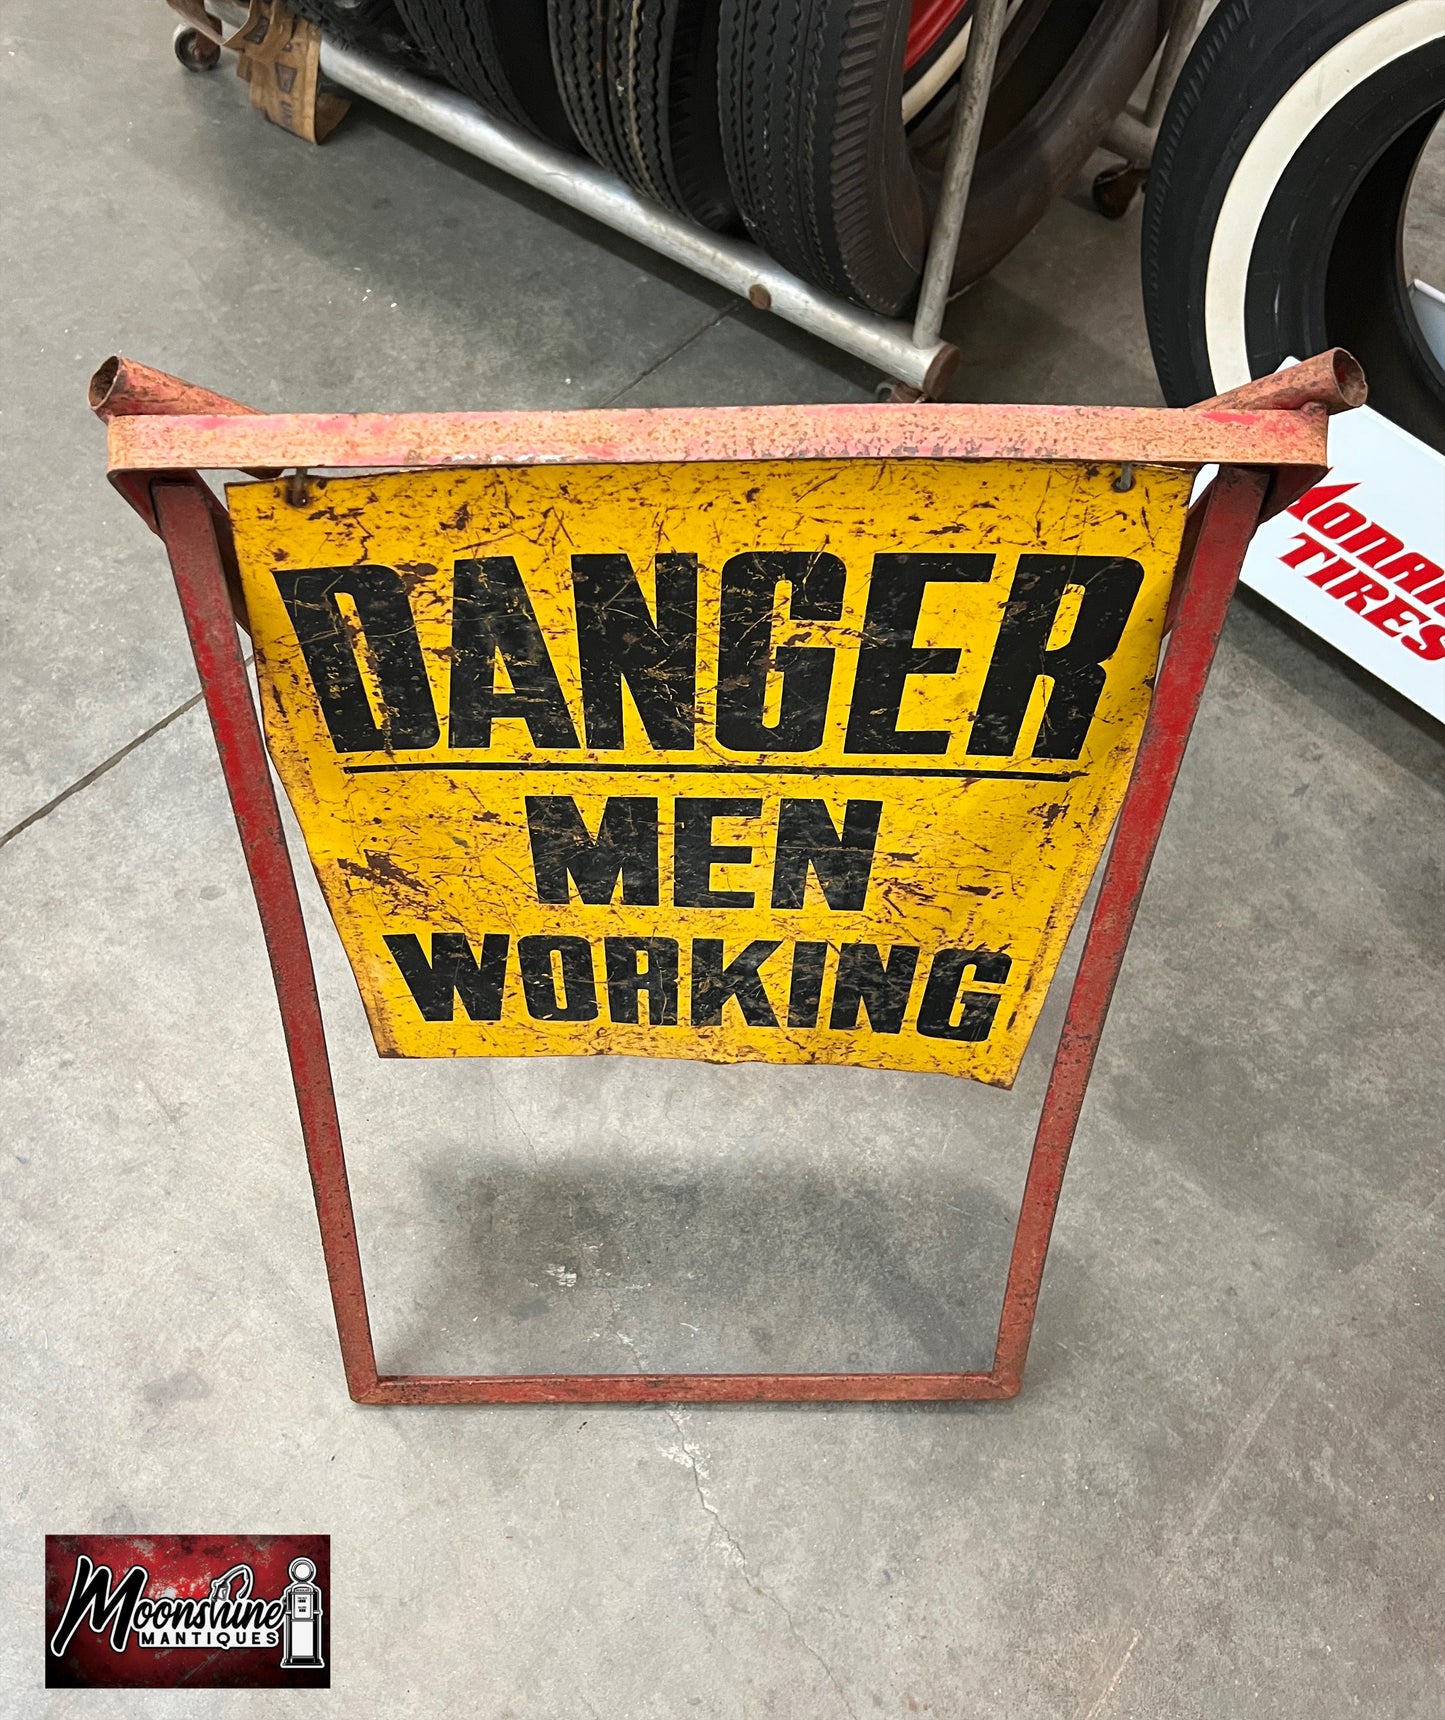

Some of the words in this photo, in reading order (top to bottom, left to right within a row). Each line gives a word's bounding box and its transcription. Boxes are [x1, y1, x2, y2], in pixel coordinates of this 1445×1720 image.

[272, 551, 1144, 761] DANGER
[1276, 532, 1445, 661] TIRES
[525, 795, 882, 911] MEN
[384, 932, 1012, 1042] WORKING
